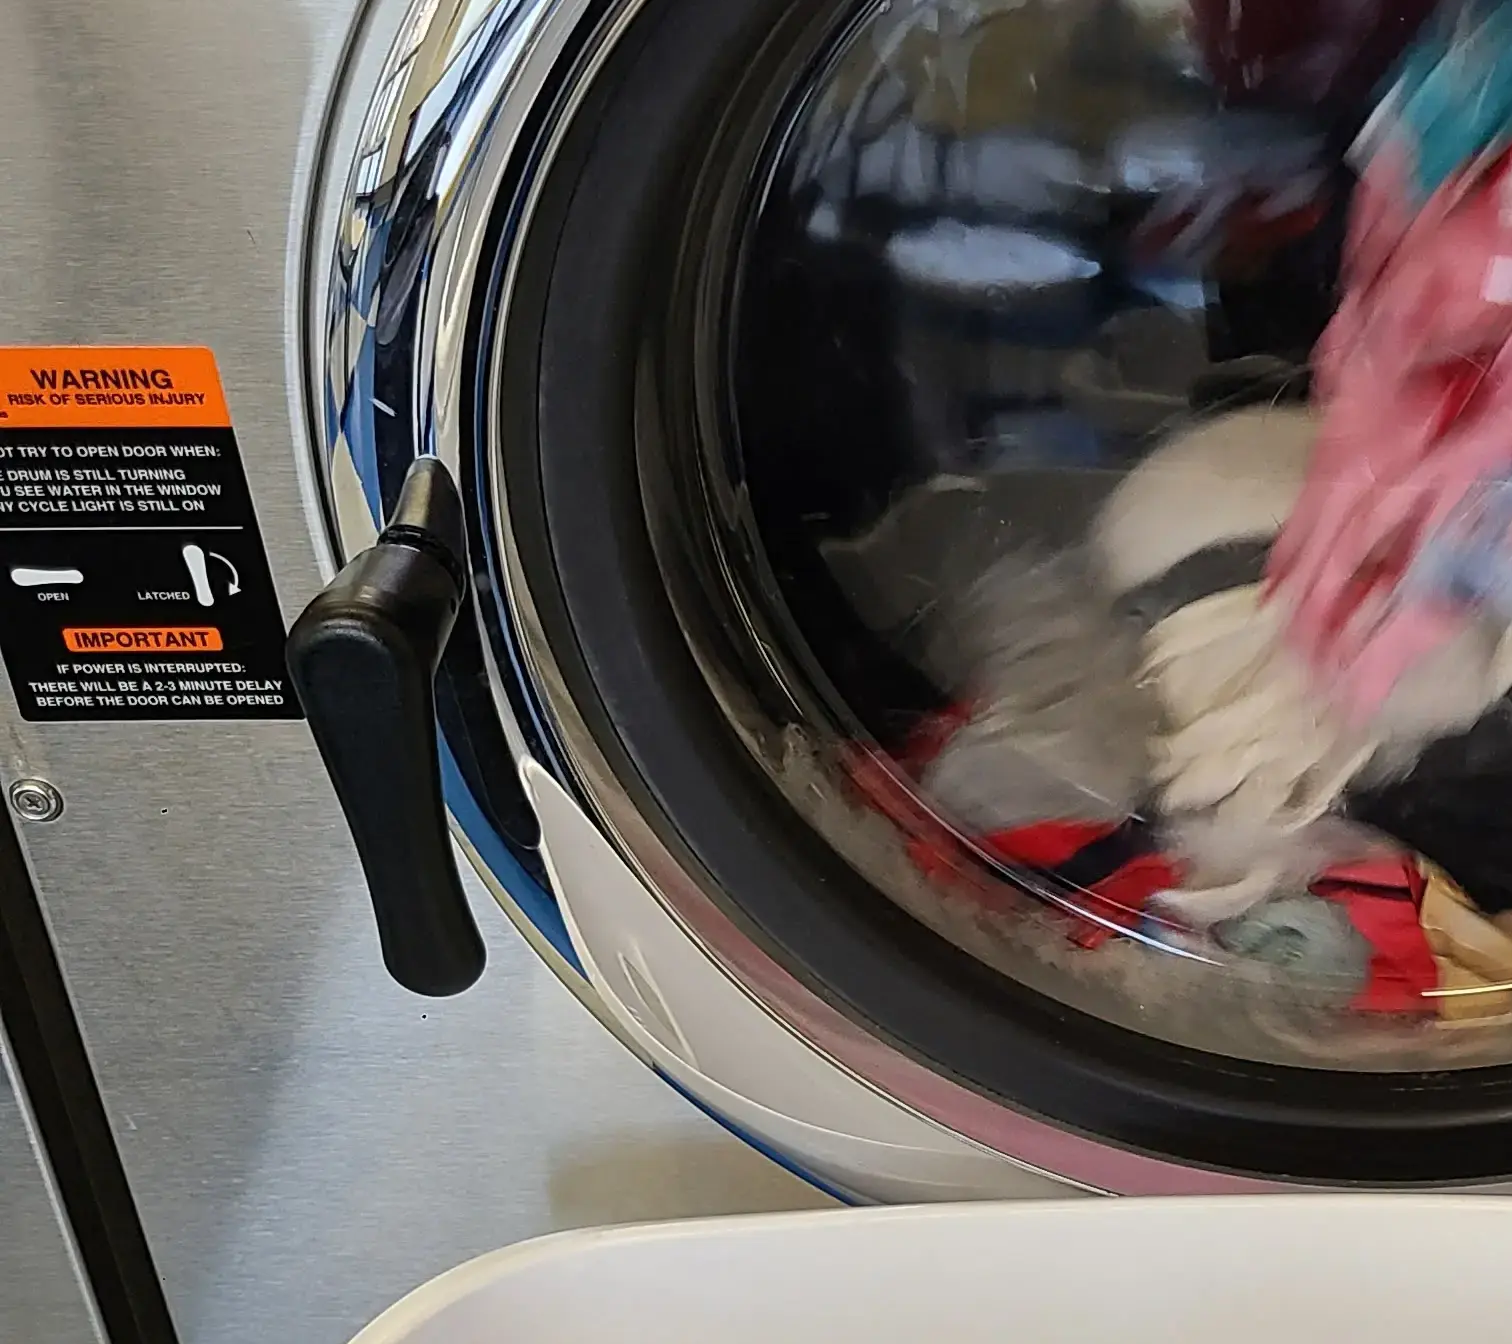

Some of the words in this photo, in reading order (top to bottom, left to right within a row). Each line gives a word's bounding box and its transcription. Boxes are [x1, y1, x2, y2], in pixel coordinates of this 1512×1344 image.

[30, 369, 174, 390] WARNING
[7, 393, 47, 406] RISK
[50, 393, 71, 405] OF
[75, 393, 146, 405] SERIOUS
[150, 393, 206, 405] INJURY
[17, 446, 47, 458] TRY
[51, 446, 73, 457] TO
[76, 446, 120, 458] OPEN
[122, 445, 168, 457] DOOR
[170, 445, 221, 457] WHEN:
[7, 470, 52, 481] DRUM
[55, 469, 70, 481] IS
[73, 469, 116, 481] STILL
[118, 469, 186, 481] TURNING
[14, 485, 45, 496] SEE
[47, 485, 102, 496] WATER
[105, 484, 120, 496] IN
[123, 484, 153, 496] THE
[156, 484, 222, 496] WINDOW
[18, 501, 69, 512] CYCLE
[71, 500, 115, 512] LIGHT
[118, 500, 134, 511] IS
[137, 500, 180, 511] STILL
[182, 499, 206, 511] ON
[37, 592, 69, 601] OPEN
[137, 591, 190, 601] LATCHED
[74, 632, 209, 648] IMPORTANT
[56, 663, 69, 674] IF
[73, 663, 125, 674] POWER
[127, 663, 142, 674] IS
[144, 662, 246, 674] INTERRUPTED:
[28, 682, 78, 693] THERE
[80, 681, 116, 692] WILL
[118, 681, 138, 692] BE
[142, 681, 152, 692] A
[154, 681, 176, 692] 2-3
[179, 681, 231, 691] MINUTE
[235, 680, 282, 691] DELAY
[36, 696, 94, 707] BEFORE
[95, 696, 125, 706] THE
[127, 695, 169, 706] DOOR
[171, 695, 201, 706] CAN
[204, 695, 224, 706] BE
[226, 695, 284, 706] OPENED
